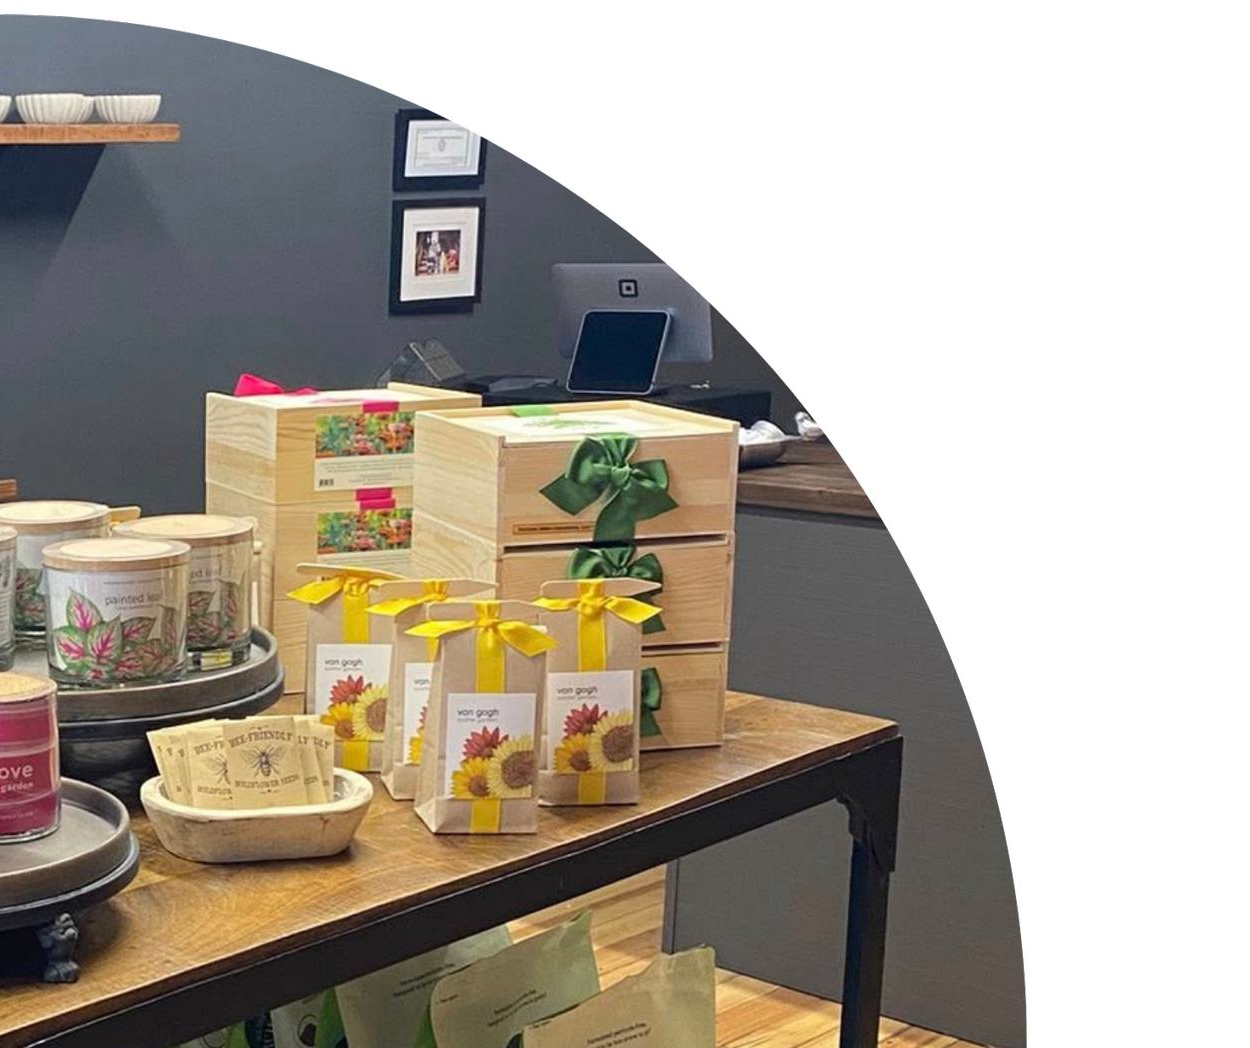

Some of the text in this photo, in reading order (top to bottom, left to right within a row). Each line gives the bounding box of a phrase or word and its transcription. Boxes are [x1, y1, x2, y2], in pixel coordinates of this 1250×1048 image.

[105, 593, 144, 606] painted
[341, 658, 363, 668] gogh
[575, 686, 598, 695] gogh
[476, 708, 499, 718] gogh
[228, 730, 293, 748] BEE-FRIENDLY
